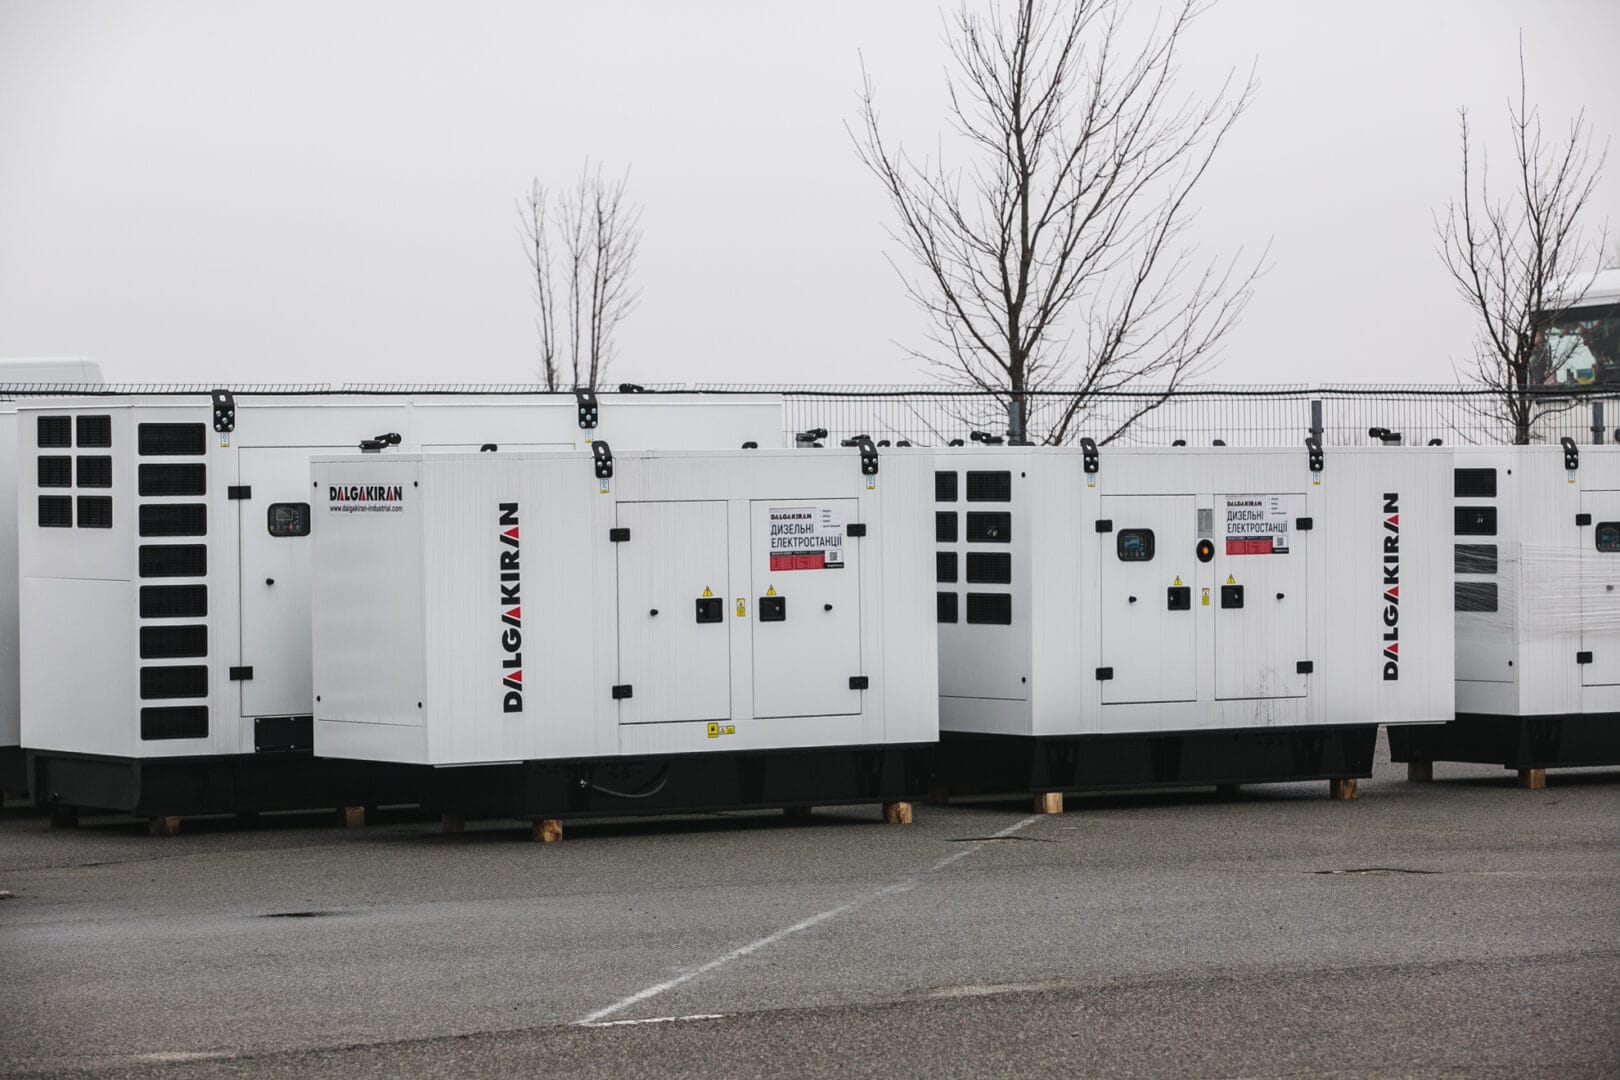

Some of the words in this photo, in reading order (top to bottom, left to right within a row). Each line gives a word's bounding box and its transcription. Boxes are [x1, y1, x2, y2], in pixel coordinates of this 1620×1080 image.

[329, 486, 402, 501] DALGAKIRAN
[330, 504, 402, 513] www.dalgakiran-industrial.com
[1227, 510, 1264, 522] ДИЗЕЛЬНІ
[770, 523, 814, 536] ДИЗЕЛЬНІ
[1227, 520, 1288, 533] ЕЛЕКТРОСТАНЦІЇ
[771, 533, 842, 548] ЕЛЕКТРОСТАНЦІЇ
[1383, 493, 1399, 680] DALGAKIRAN
[499, 502, 523, 713] DALGAKIRAN
